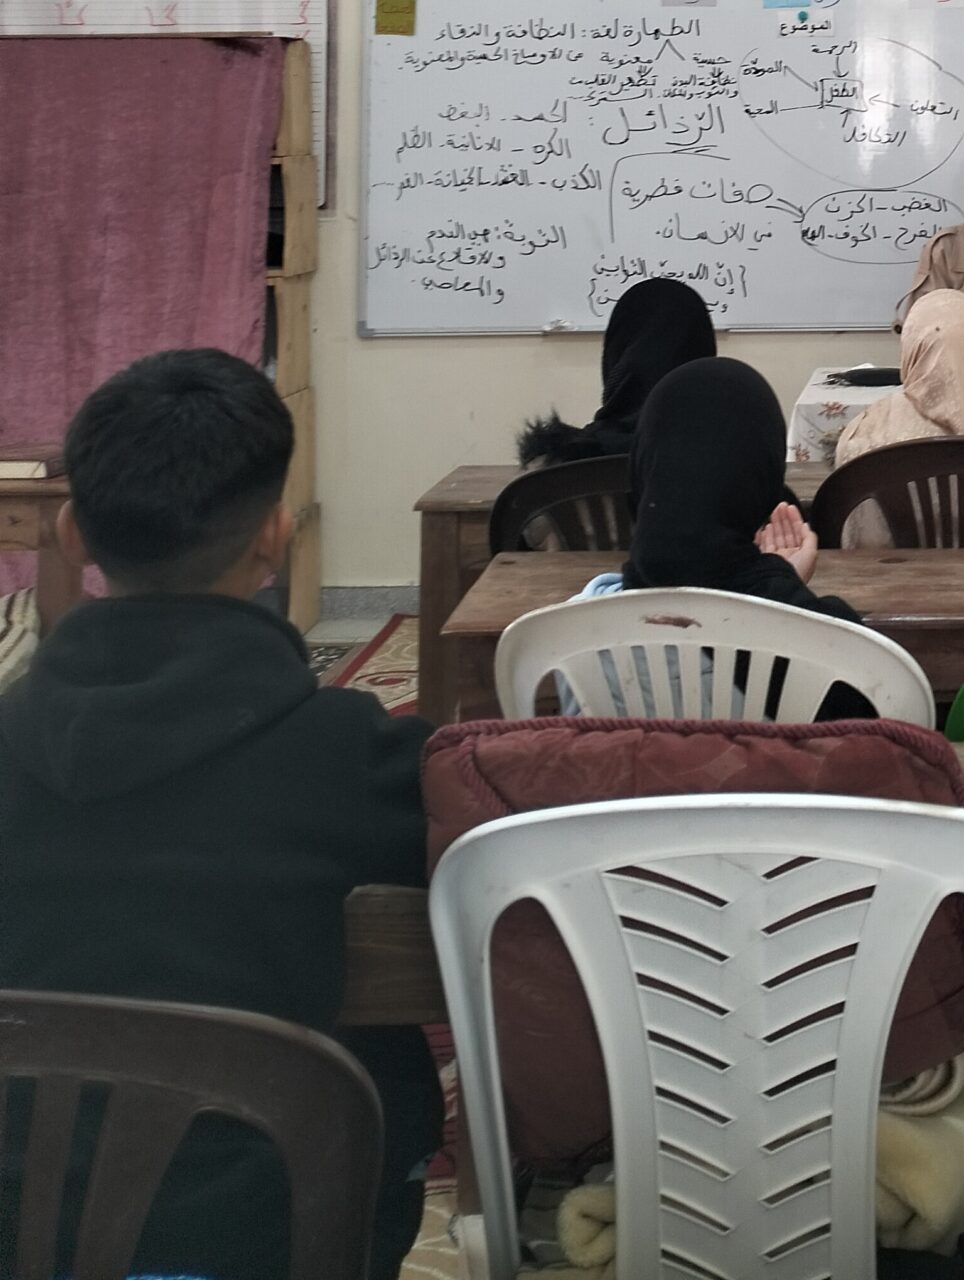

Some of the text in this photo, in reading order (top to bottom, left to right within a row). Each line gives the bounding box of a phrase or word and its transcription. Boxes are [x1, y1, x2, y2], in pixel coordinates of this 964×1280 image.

[503, 18, 575, 40] النظافة
[623, 17, 700, 47] الطهارة
[779, 19, 832, 37] الموضوع
[600, 51, 654, 70] معنوية
[811, 40, 858, 56] الرحمة
[551, 162, 601, 192] الكذب
[689, 177, 774, 204] صفات
[825, 193, 948, 222] الغضب الحزن
[425, 219, 466, 253] الندم
[834, 222, 877, 249] الخوف
[687, 262, 709, 281] الله
